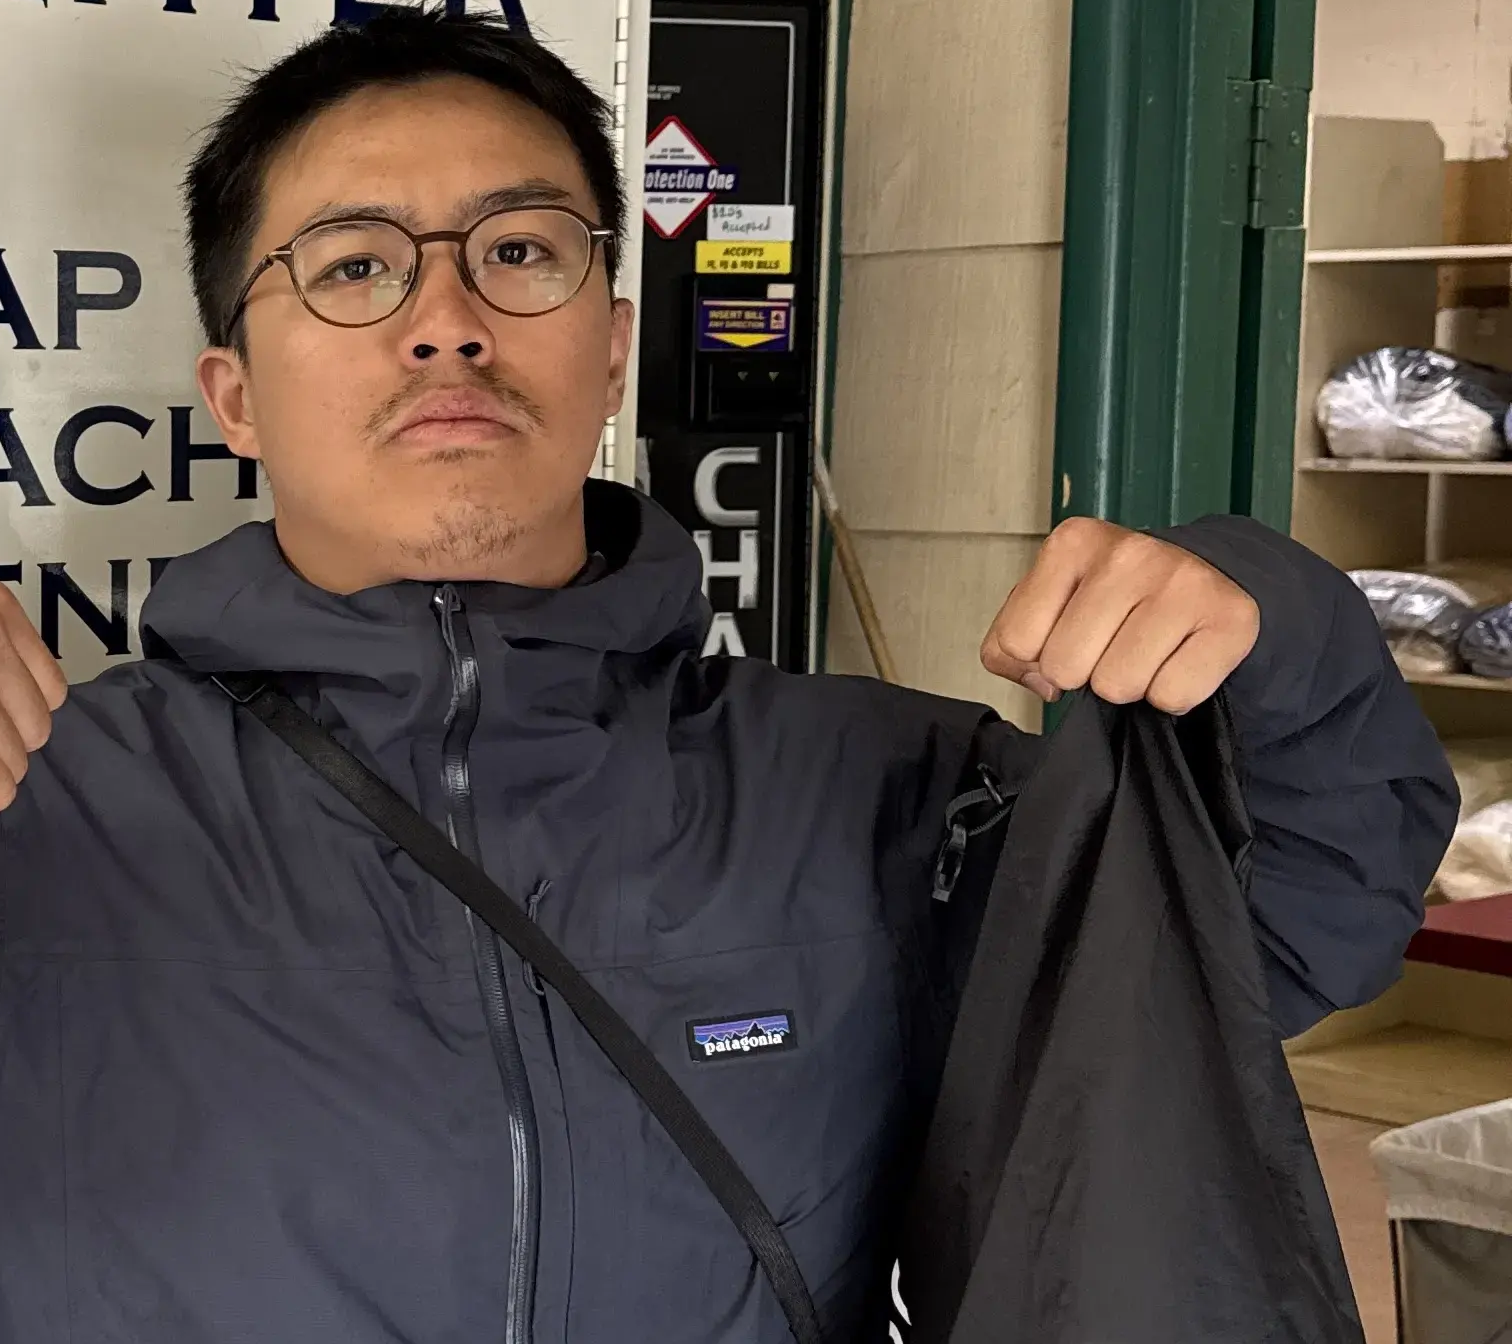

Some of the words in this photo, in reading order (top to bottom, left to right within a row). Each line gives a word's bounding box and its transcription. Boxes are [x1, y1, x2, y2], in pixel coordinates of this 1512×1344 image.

[645, 167, 705, 190] otection
[707, 168, 736, 191] One
[722, 247, 765, 257] ACCEPTS
[703, 1030, 784, 1056] patagonia
